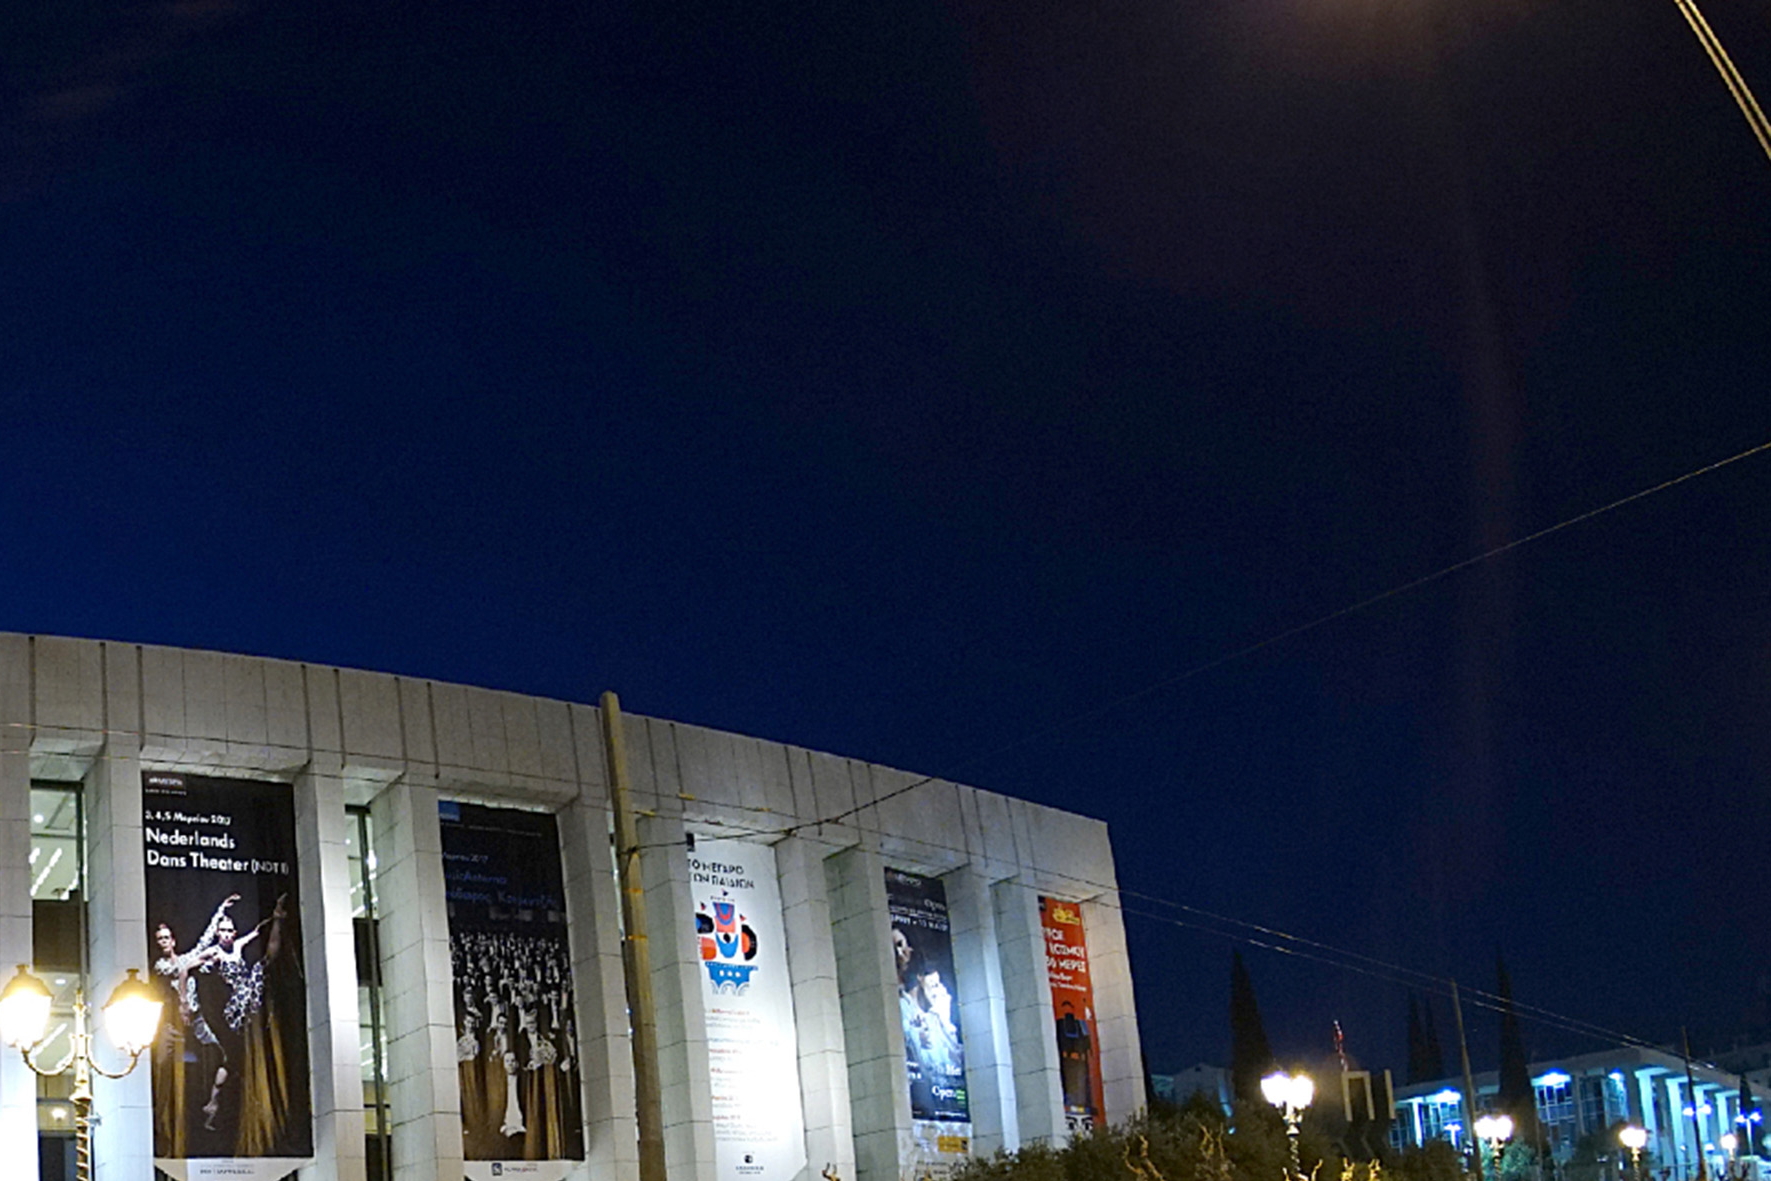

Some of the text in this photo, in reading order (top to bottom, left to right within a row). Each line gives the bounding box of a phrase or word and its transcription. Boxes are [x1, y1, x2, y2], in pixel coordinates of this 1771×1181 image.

[145, 827, 236, 849] Nederlands
[147, 849, 187, 868] Dans
[189, 851, 249, 872] Theater
[689, 872, 710, 882] ΩΝ
